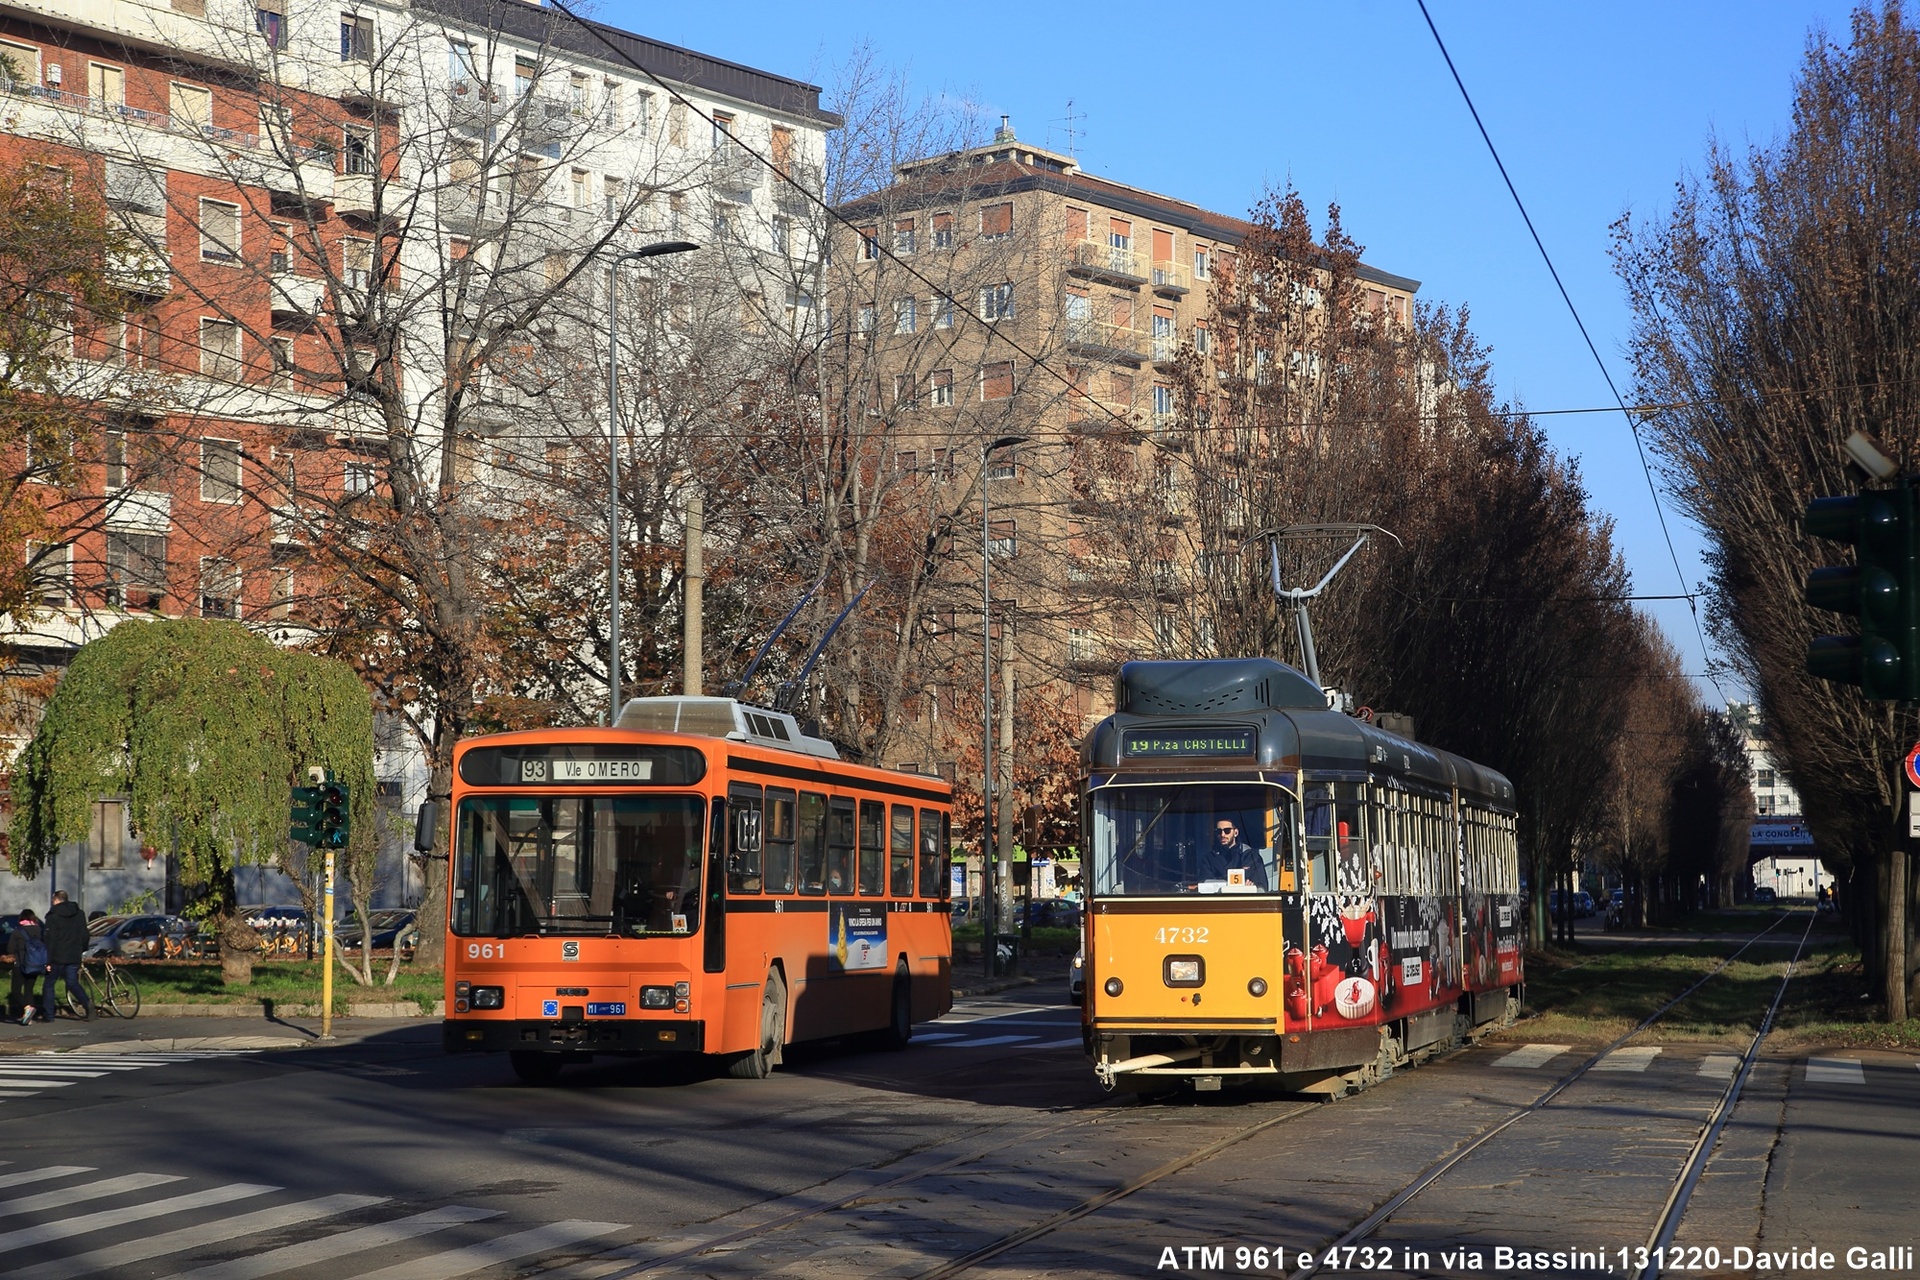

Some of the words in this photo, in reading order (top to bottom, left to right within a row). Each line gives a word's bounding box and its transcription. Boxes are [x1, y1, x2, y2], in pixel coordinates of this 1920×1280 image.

[1131, 741, 1149, 751] 19
[1153, 741, 1179, 750] P.za
[1184, 739, 1247, 750] CASTELLI
[524, 760, 545, 778] 93
[565, 762, 582, 777] V.le
[587, 762, 640, 777] OMERO
[1233, 875, 1239, 884] 5
[1154, 926, 1210, 944] 4732
[468, 943, 505, 959] 961
[588, 1004, 597, 1014] MI
[609, 1004, 625, 1014] 961
